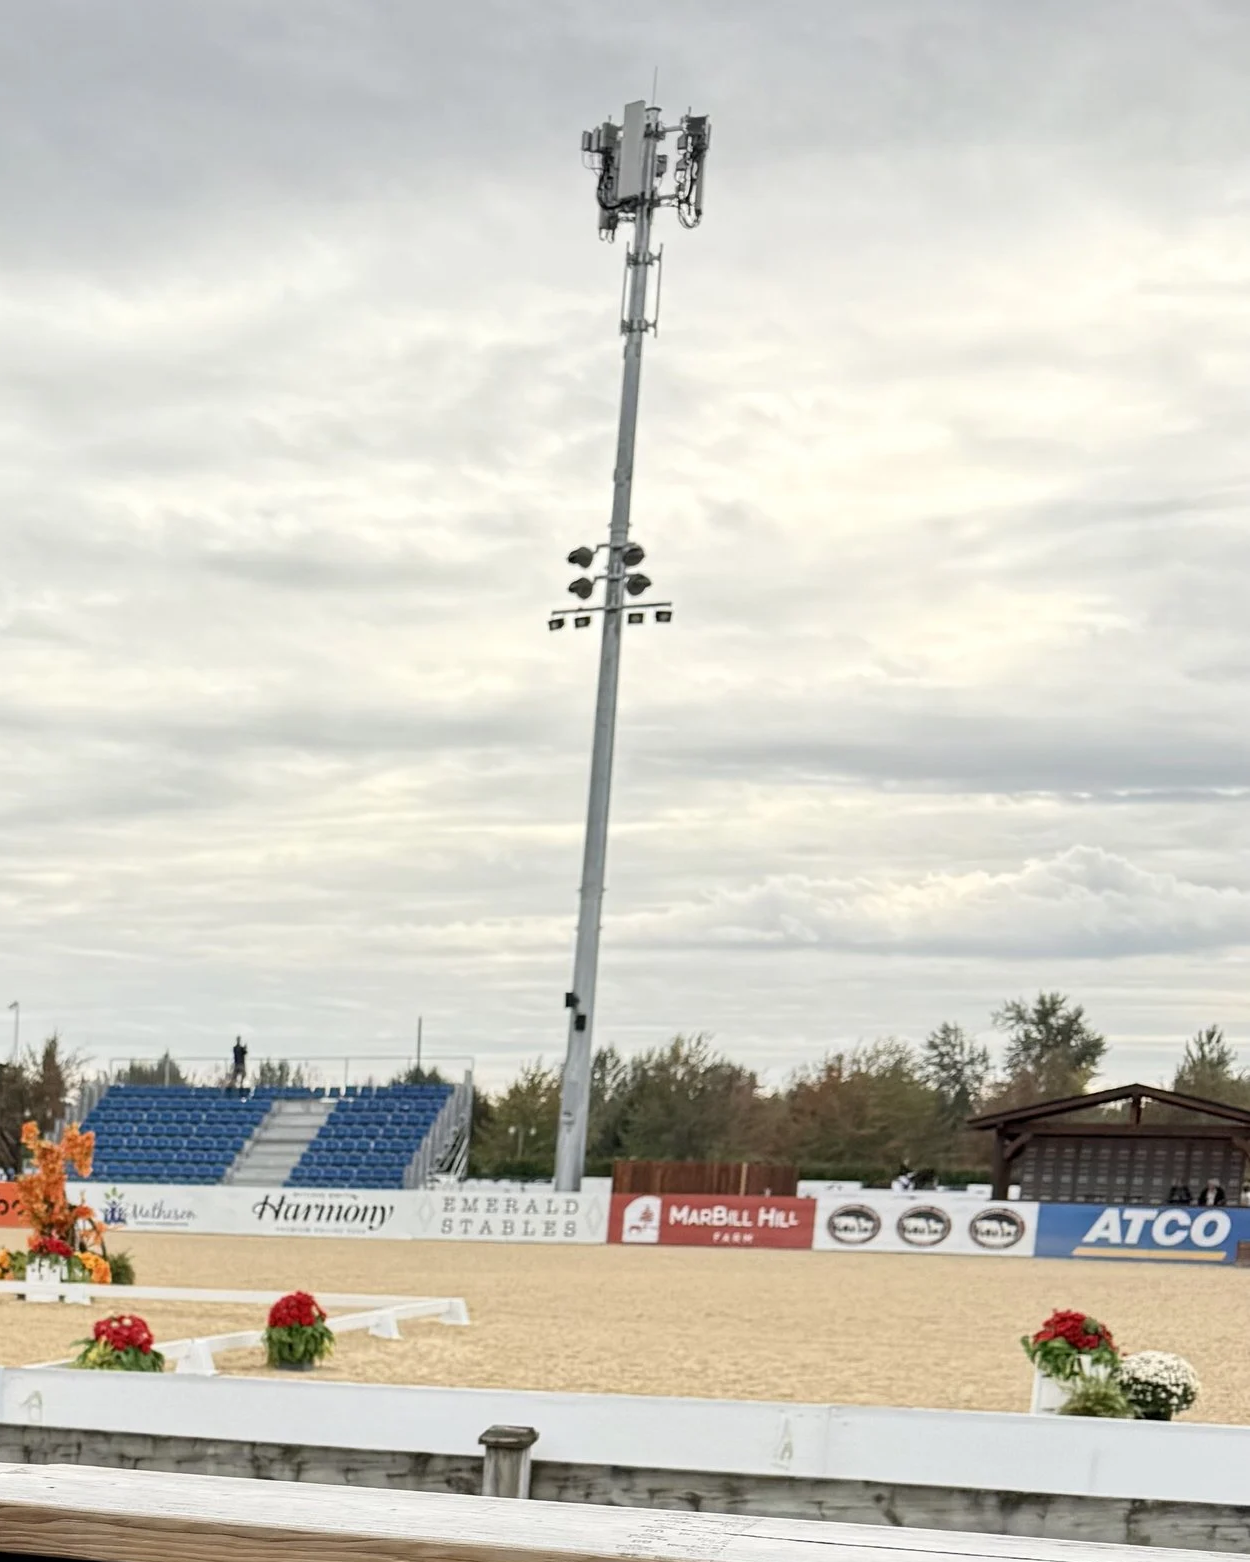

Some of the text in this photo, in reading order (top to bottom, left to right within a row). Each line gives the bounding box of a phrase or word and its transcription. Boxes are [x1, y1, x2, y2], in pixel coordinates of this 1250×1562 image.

[252, 1194, 394, 1231] Harmony
[442, 1196, 579, 1216] EMERALD
[757, 1206, 799, 1228] HILL
[1082, 1207, 1232, 1248] ATCO
[441, 1219, 577, 1237] STABLES
[712, 1231, 754, 1244] FARM
